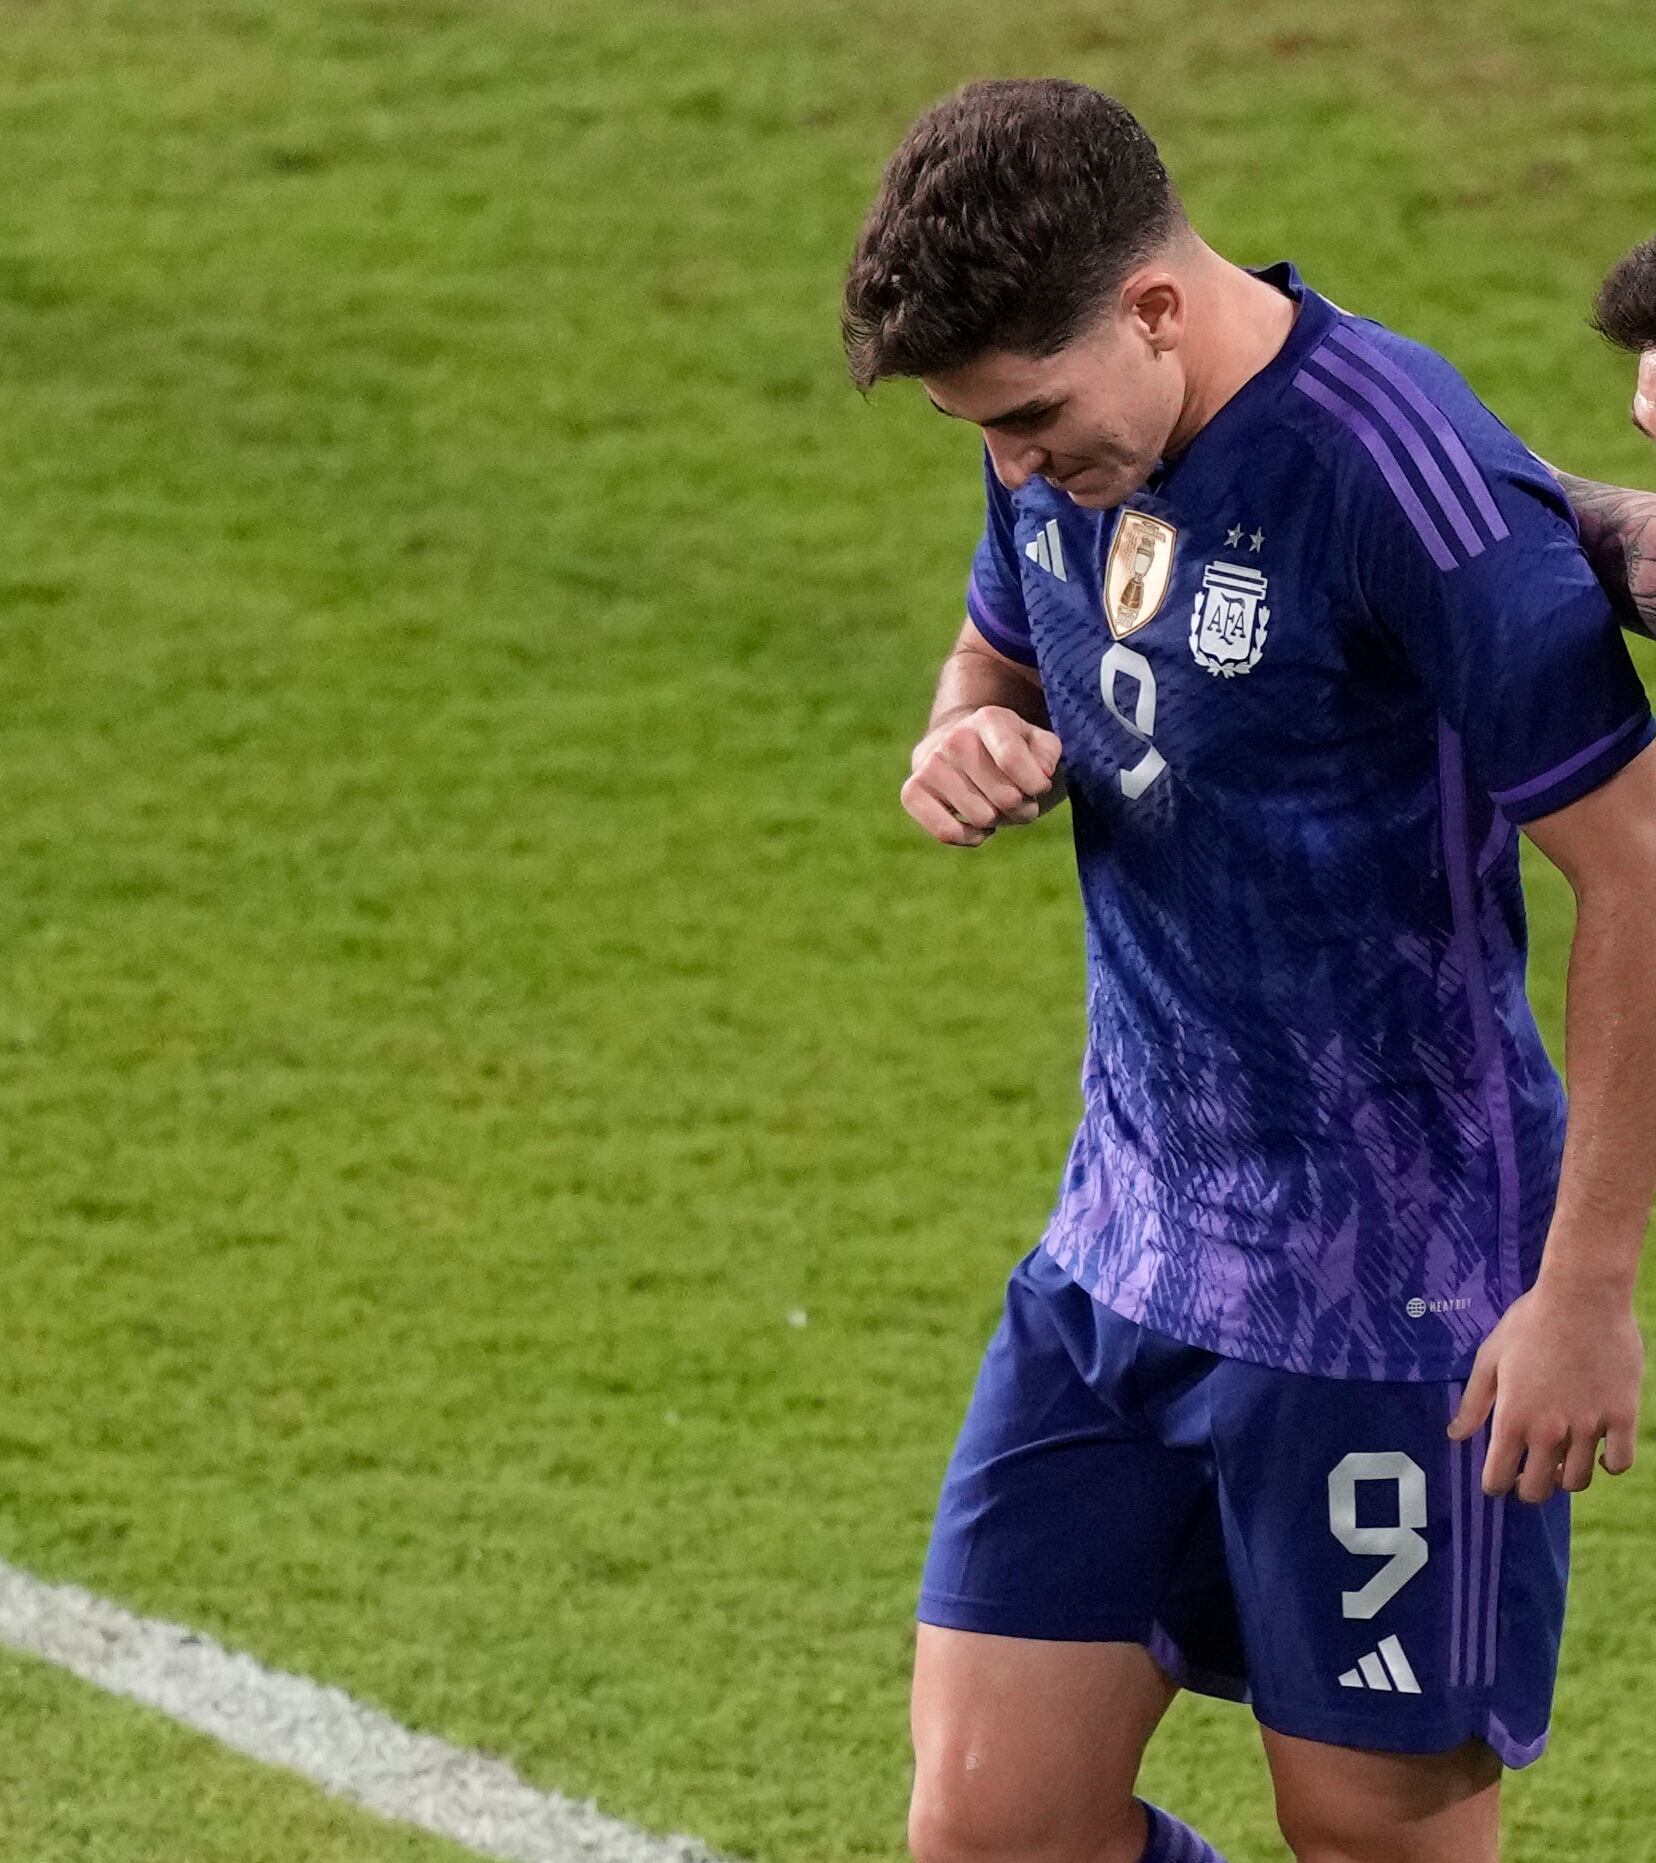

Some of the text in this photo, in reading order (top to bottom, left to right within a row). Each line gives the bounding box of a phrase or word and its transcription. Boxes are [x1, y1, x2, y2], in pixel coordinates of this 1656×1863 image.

[1207, 592, 1246, 645] AFA
[1100, 642, 1167, 800] 9
[1328, 1451, 1428, 1619] 9
